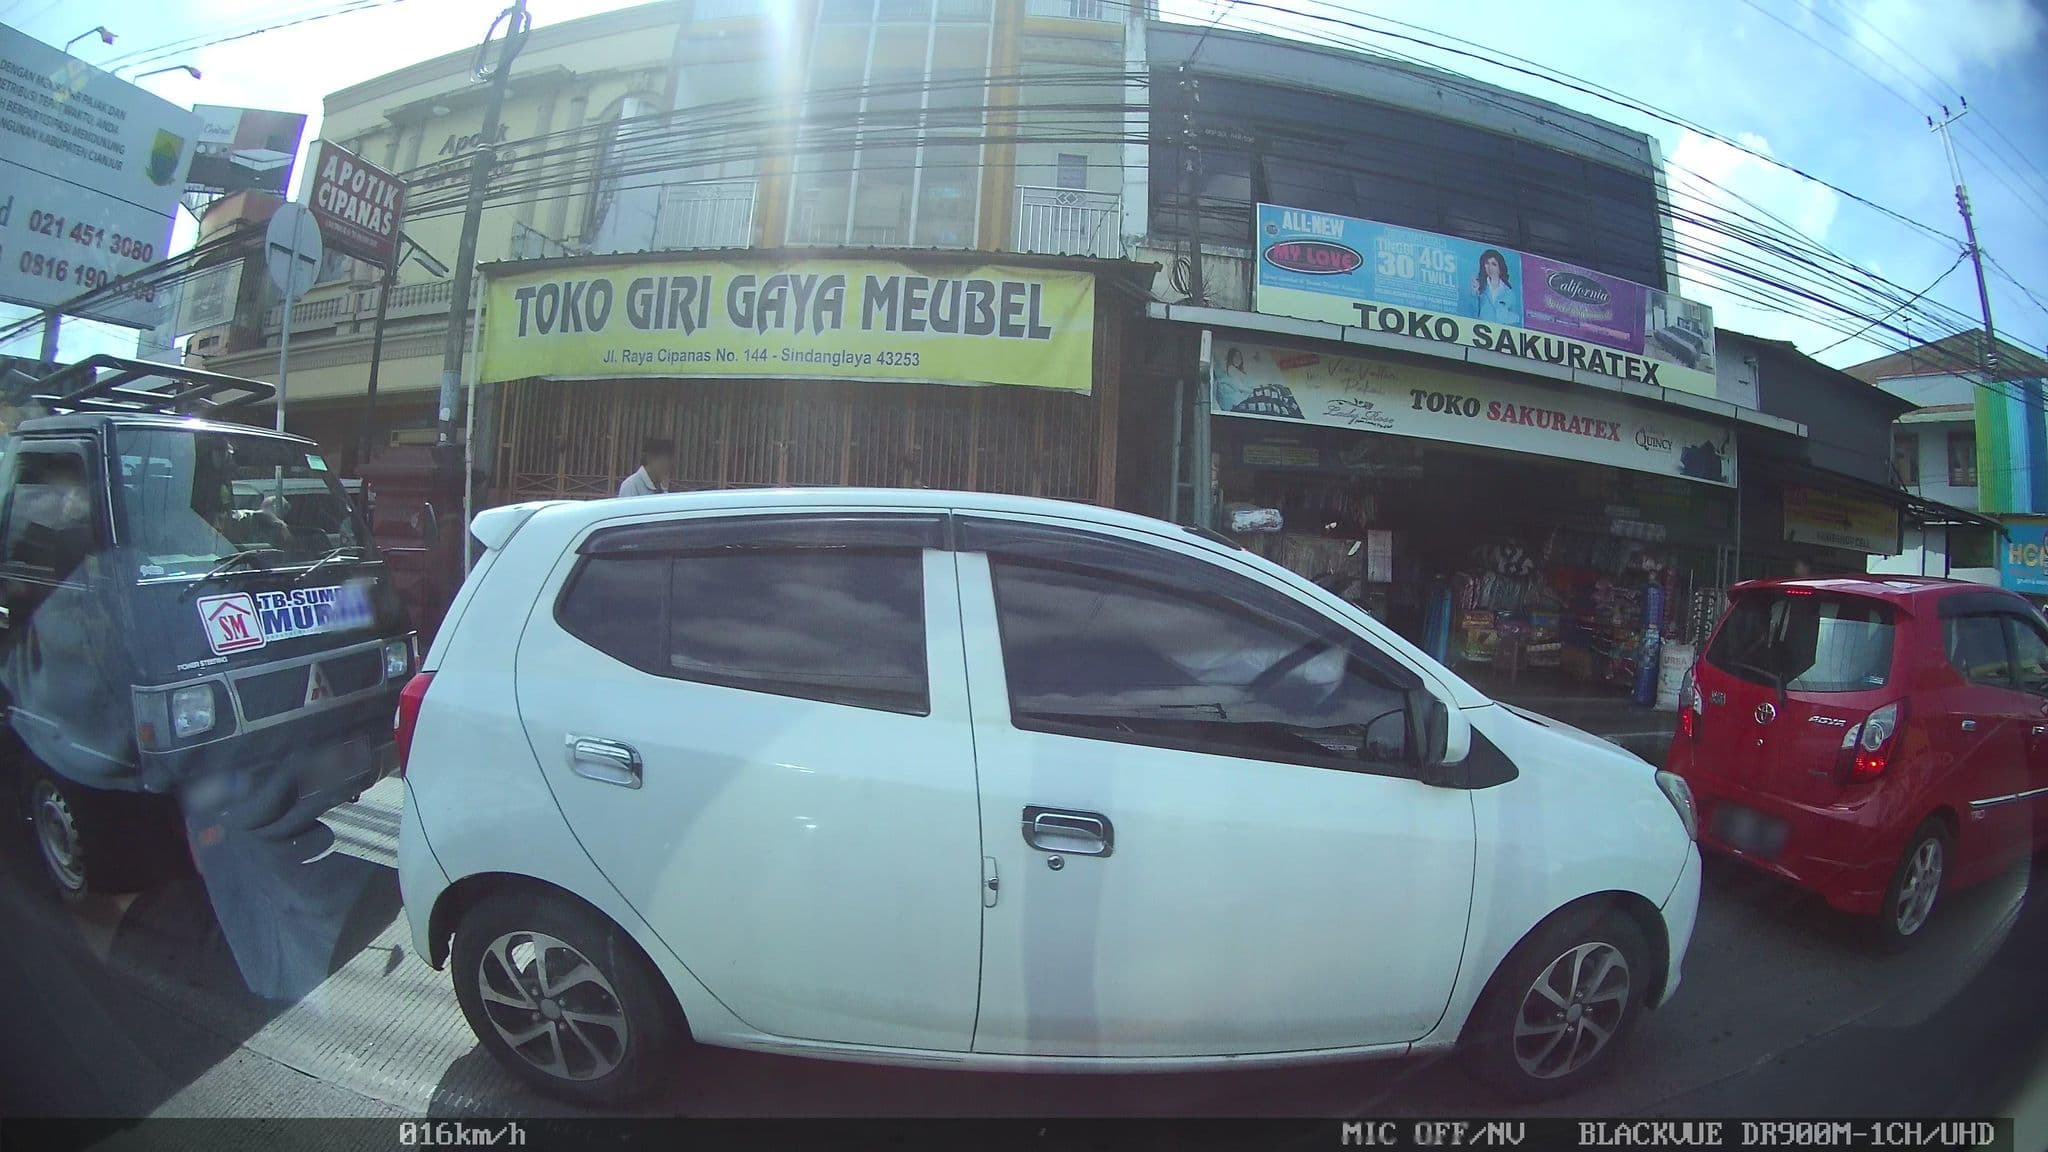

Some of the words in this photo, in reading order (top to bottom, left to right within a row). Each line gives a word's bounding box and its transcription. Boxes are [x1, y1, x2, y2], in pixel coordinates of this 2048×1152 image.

[0, 77, 38, 101] ETRIBUSI
[0, 117, 38, 140] NGUNAN
[321, 154, 400, 211] APOTIK
[318, 182, 394, 236] CIPANAS
[29, 209, 66, 239] 021
[69, 222, 105, 249] 451
[109, 233, 154, 263] 3080
[20, 250, 69, 282] 0816
[74, 264, 108, 289] 190
[1273, 243, 1301, 261] MY
[1306, 247, 1353, 272] LOVE
[1377, 251, 1415, 279] 30
[1546, 269, 1609, 301] California
[515, 278, 613, 338] TOKO
[626, 275, 712, 337] GIRI
[727, 273, 846, 337] GAYA
[861, 275, 1052, 340] MEUBEL
[603, 349, 618, 364] Jl.
[622, 349, 654, 367] Raya
[657, 348, 711, 366] Cipanas
[716, 348, 738, 363] No.
[744, 349, 768, 363] 144
[781, 348, 872, 367] Sindanglaya
[877, 351, 920, 367] 43253
[1353, 302, 1460, 344] TOKO
[1472, 323, 1662, 387] SAKURATEX
[1323, 405, 1359, 425] Lady
[1410, 389, 1480, 418] TOKO
[1487, 400, 1622, 442] SAKURATEX
[218, 613, 251, 642] SM
